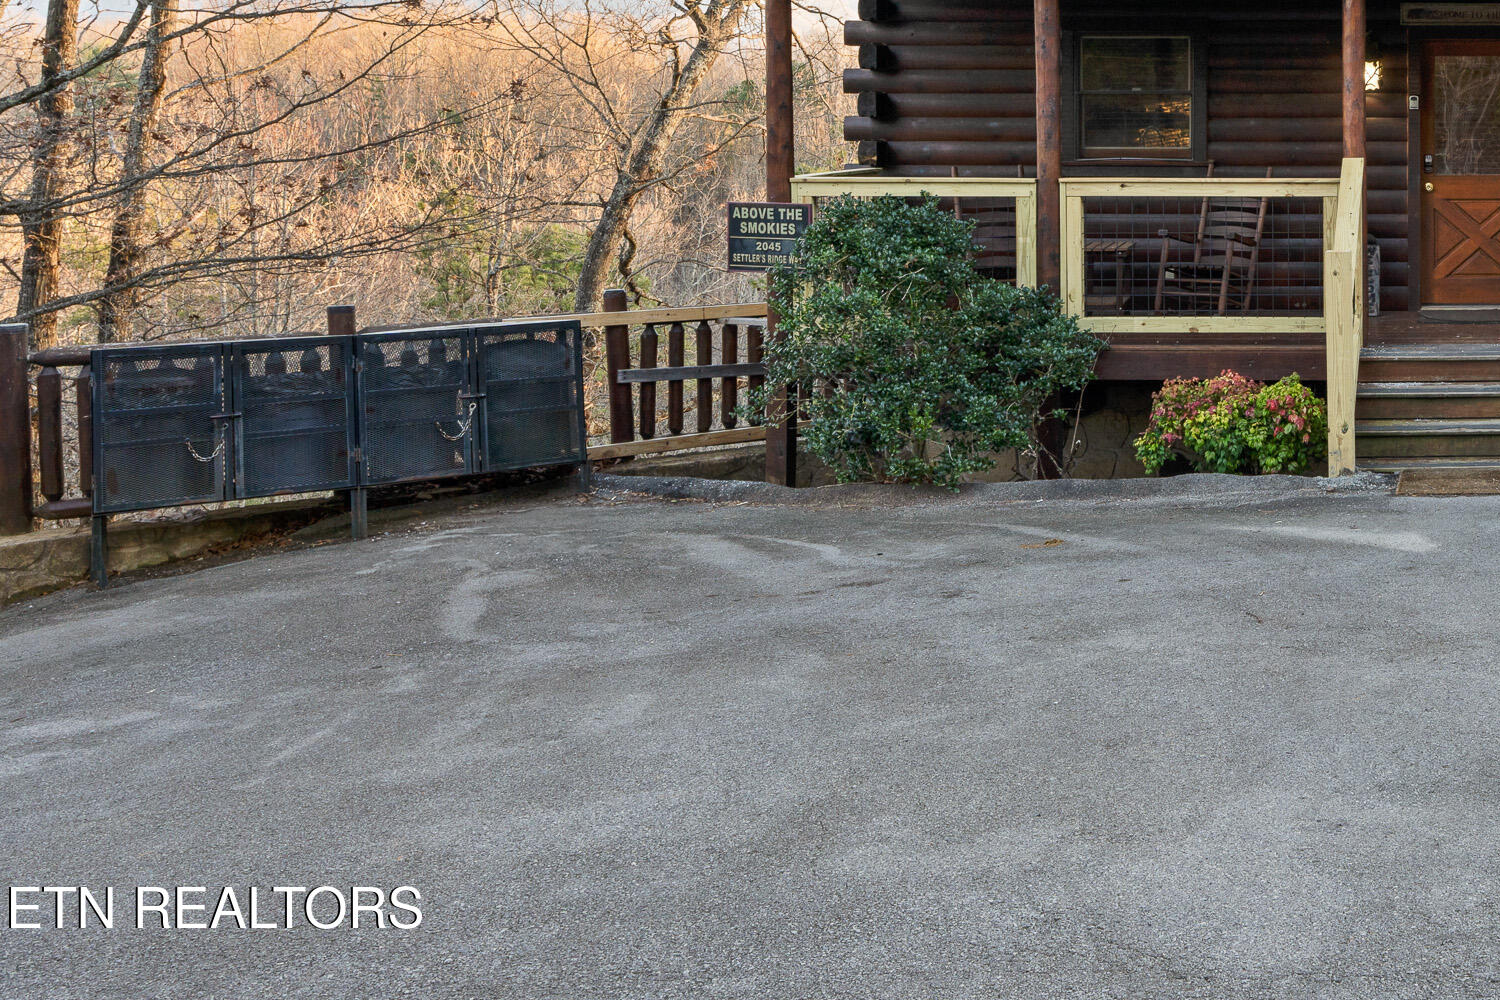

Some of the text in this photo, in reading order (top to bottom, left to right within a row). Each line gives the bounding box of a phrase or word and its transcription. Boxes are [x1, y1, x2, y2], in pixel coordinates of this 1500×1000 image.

[733, 207, 803, 220] ABOVE THE
[740, 221, 796, 235] SMOKIES
[756, 241, 781, 251] 2045
[732, 253, 766, 264] SETTLER'S
[767, 254, 787, 264] RIDGE
